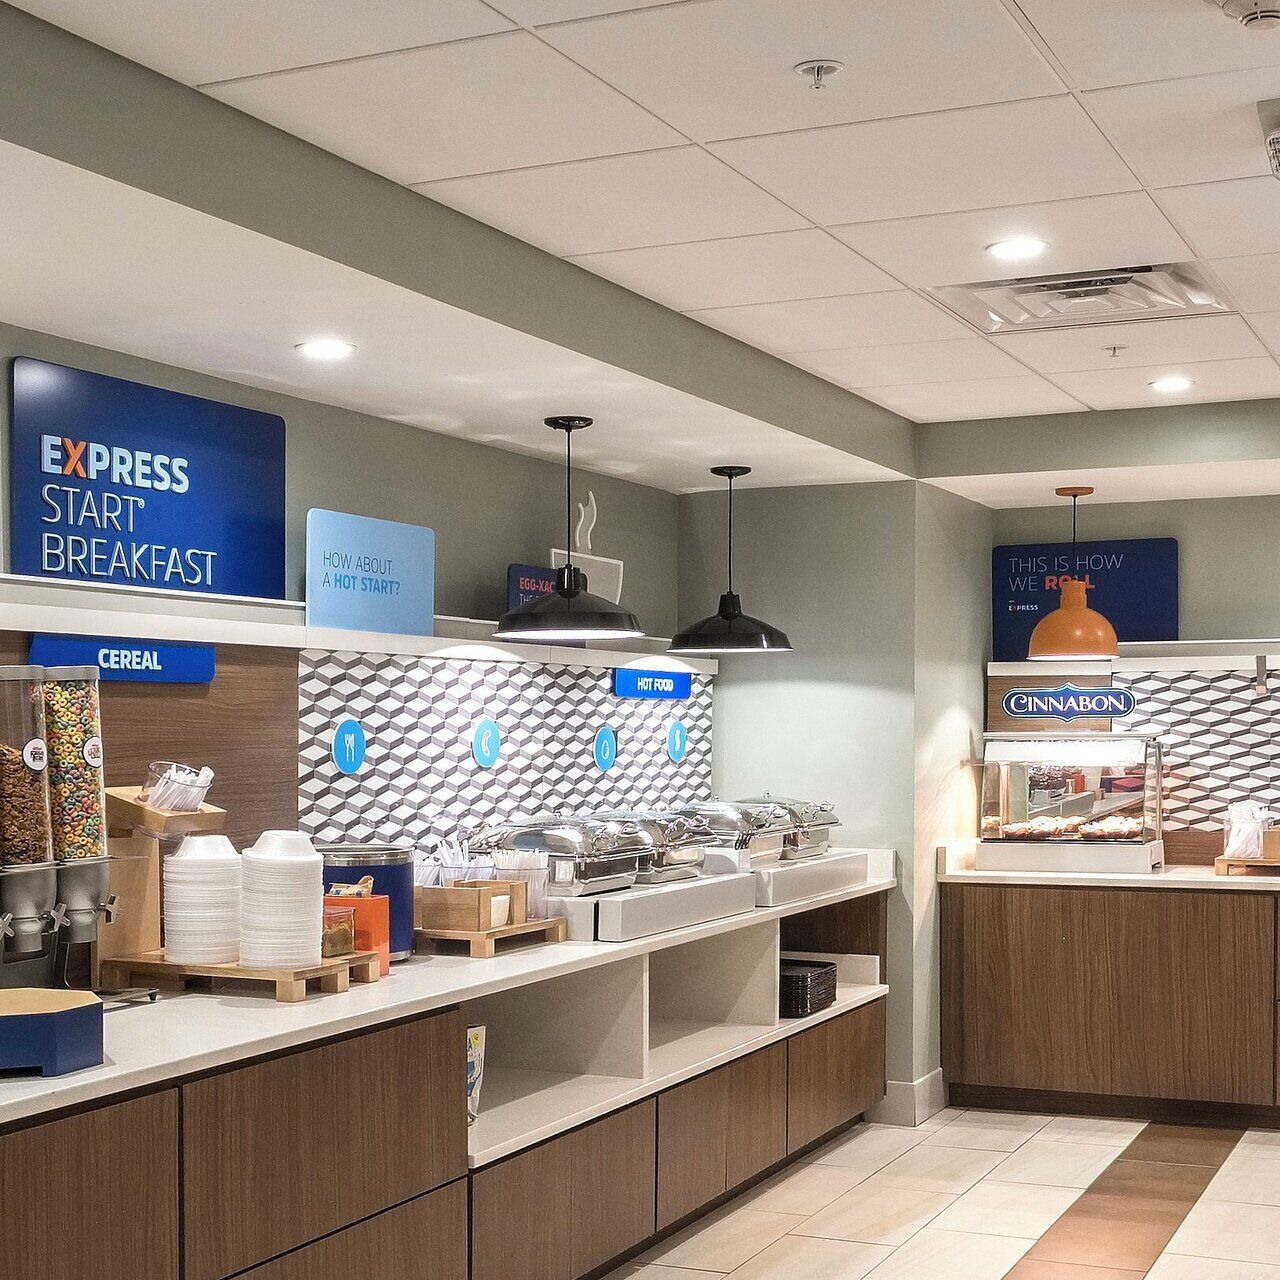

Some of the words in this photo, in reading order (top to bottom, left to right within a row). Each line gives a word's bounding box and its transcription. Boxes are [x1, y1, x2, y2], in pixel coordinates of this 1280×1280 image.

[40, 433, 190, 494] EXPRESS
[41, 533, 218, 587] BREAKFAST
[323, 550, 353, 571] HOW
[355, 555, 393, 575] ABOUT
[1008, 556, 1048, 573] THIS
[1054, 555, 1069, 572] IS
[1076, 554, 1124, 571] HOW
[322, 572, 331, 588] A
[333, 573, 358, 592] HOT
[360, 577, 401, 597] START?
[519, 577, 556, 593] EGG-XAC
[1008, 575, 1038, 592] WE
[1045, 574, 1095, 590] ROL
[97, 647, 162, 671] CEREAL
[637, 677, 653, 691] HOT
[654, 678, 674, 691] FOOD
[1009, 694, 1124, 712] CINNABON
